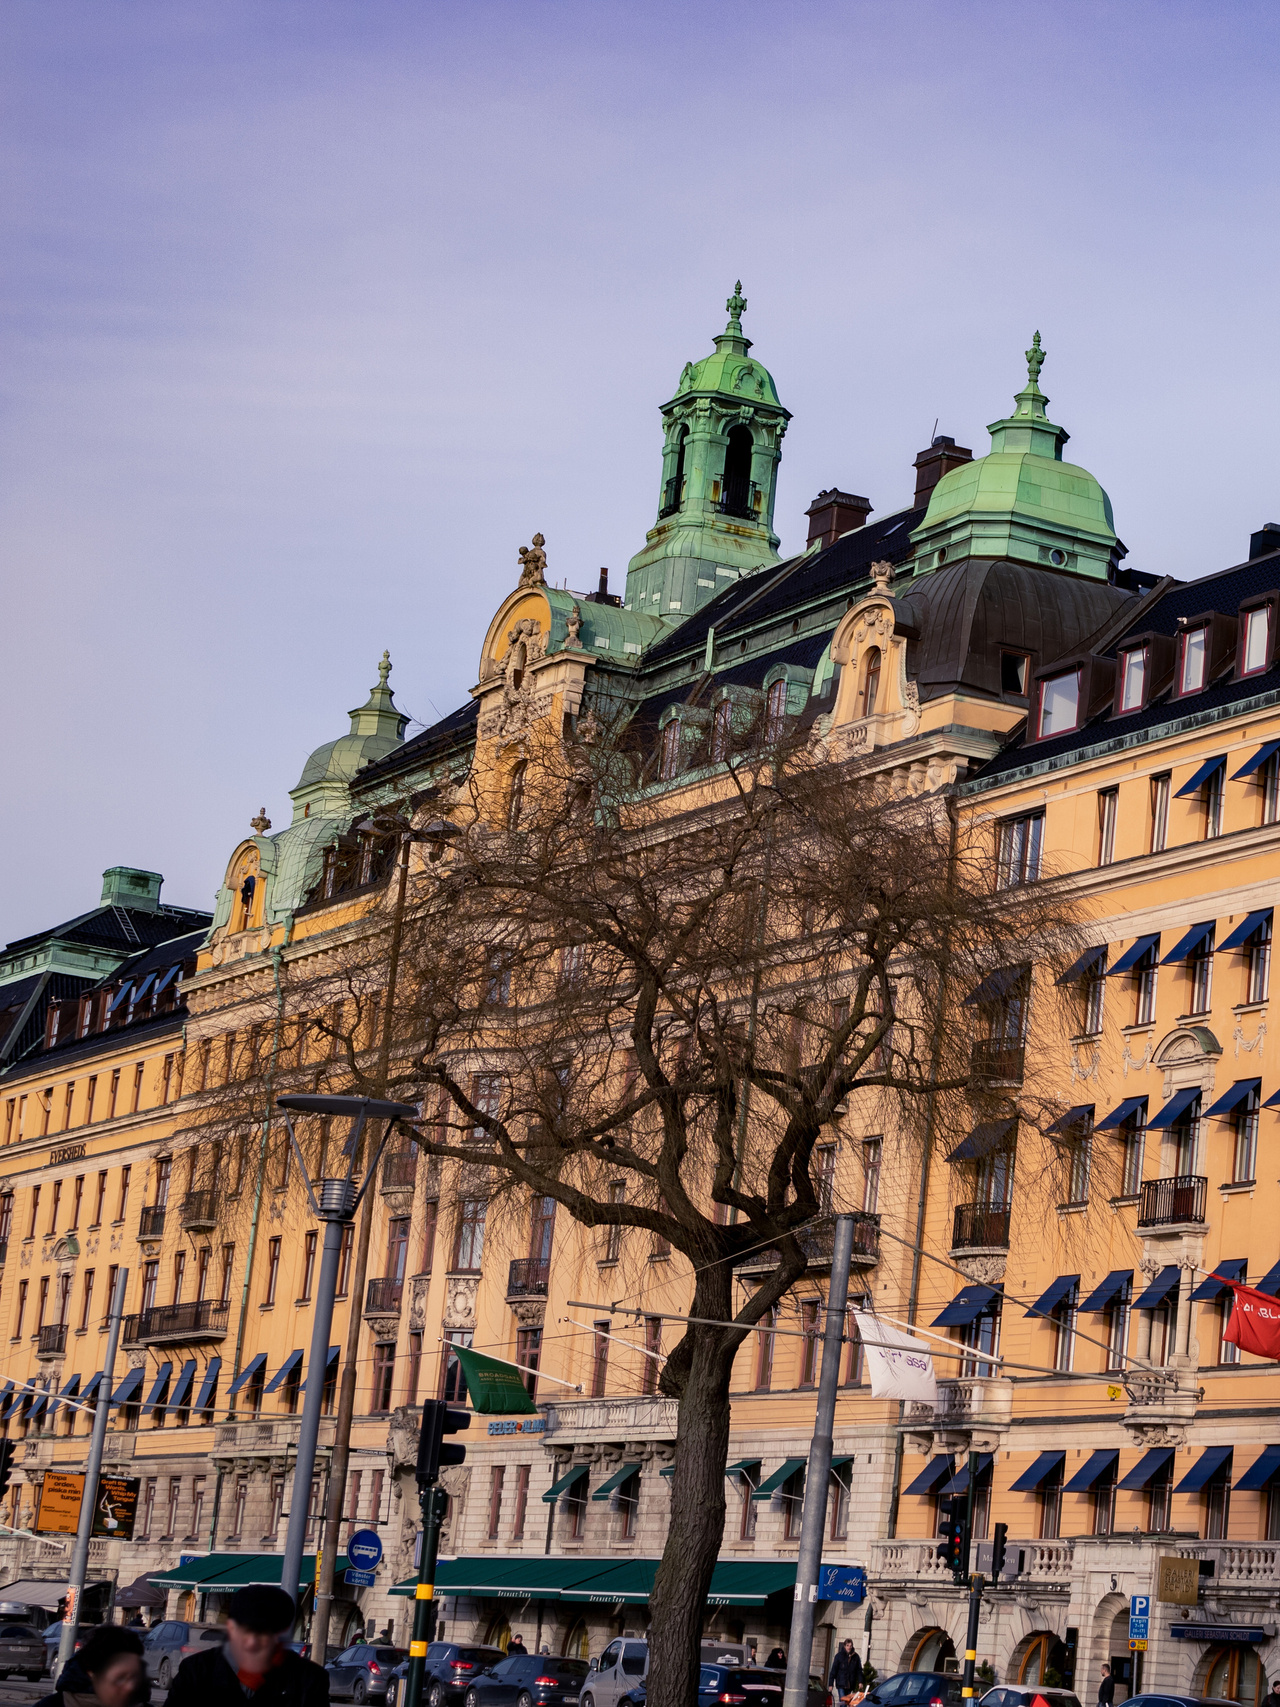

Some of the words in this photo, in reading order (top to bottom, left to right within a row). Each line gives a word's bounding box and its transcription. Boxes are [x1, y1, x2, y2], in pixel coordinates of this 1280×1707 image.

[50, 1143, 86, 1164] EVERSHEDS
[54, 1481, 76, 1489] orden,
[1164, 1568, 1195, 1577] GALLERI
[1110, 1574, 1118, 1591] 5
[1135, 1597, 1147, 1615] P
[1184, 1629, 1204, 1638] GALLERI
[1204, 1631, 1229, 1640] SEBASTIAN
[1229, 1632, 1250, 1641] SCHILDT
